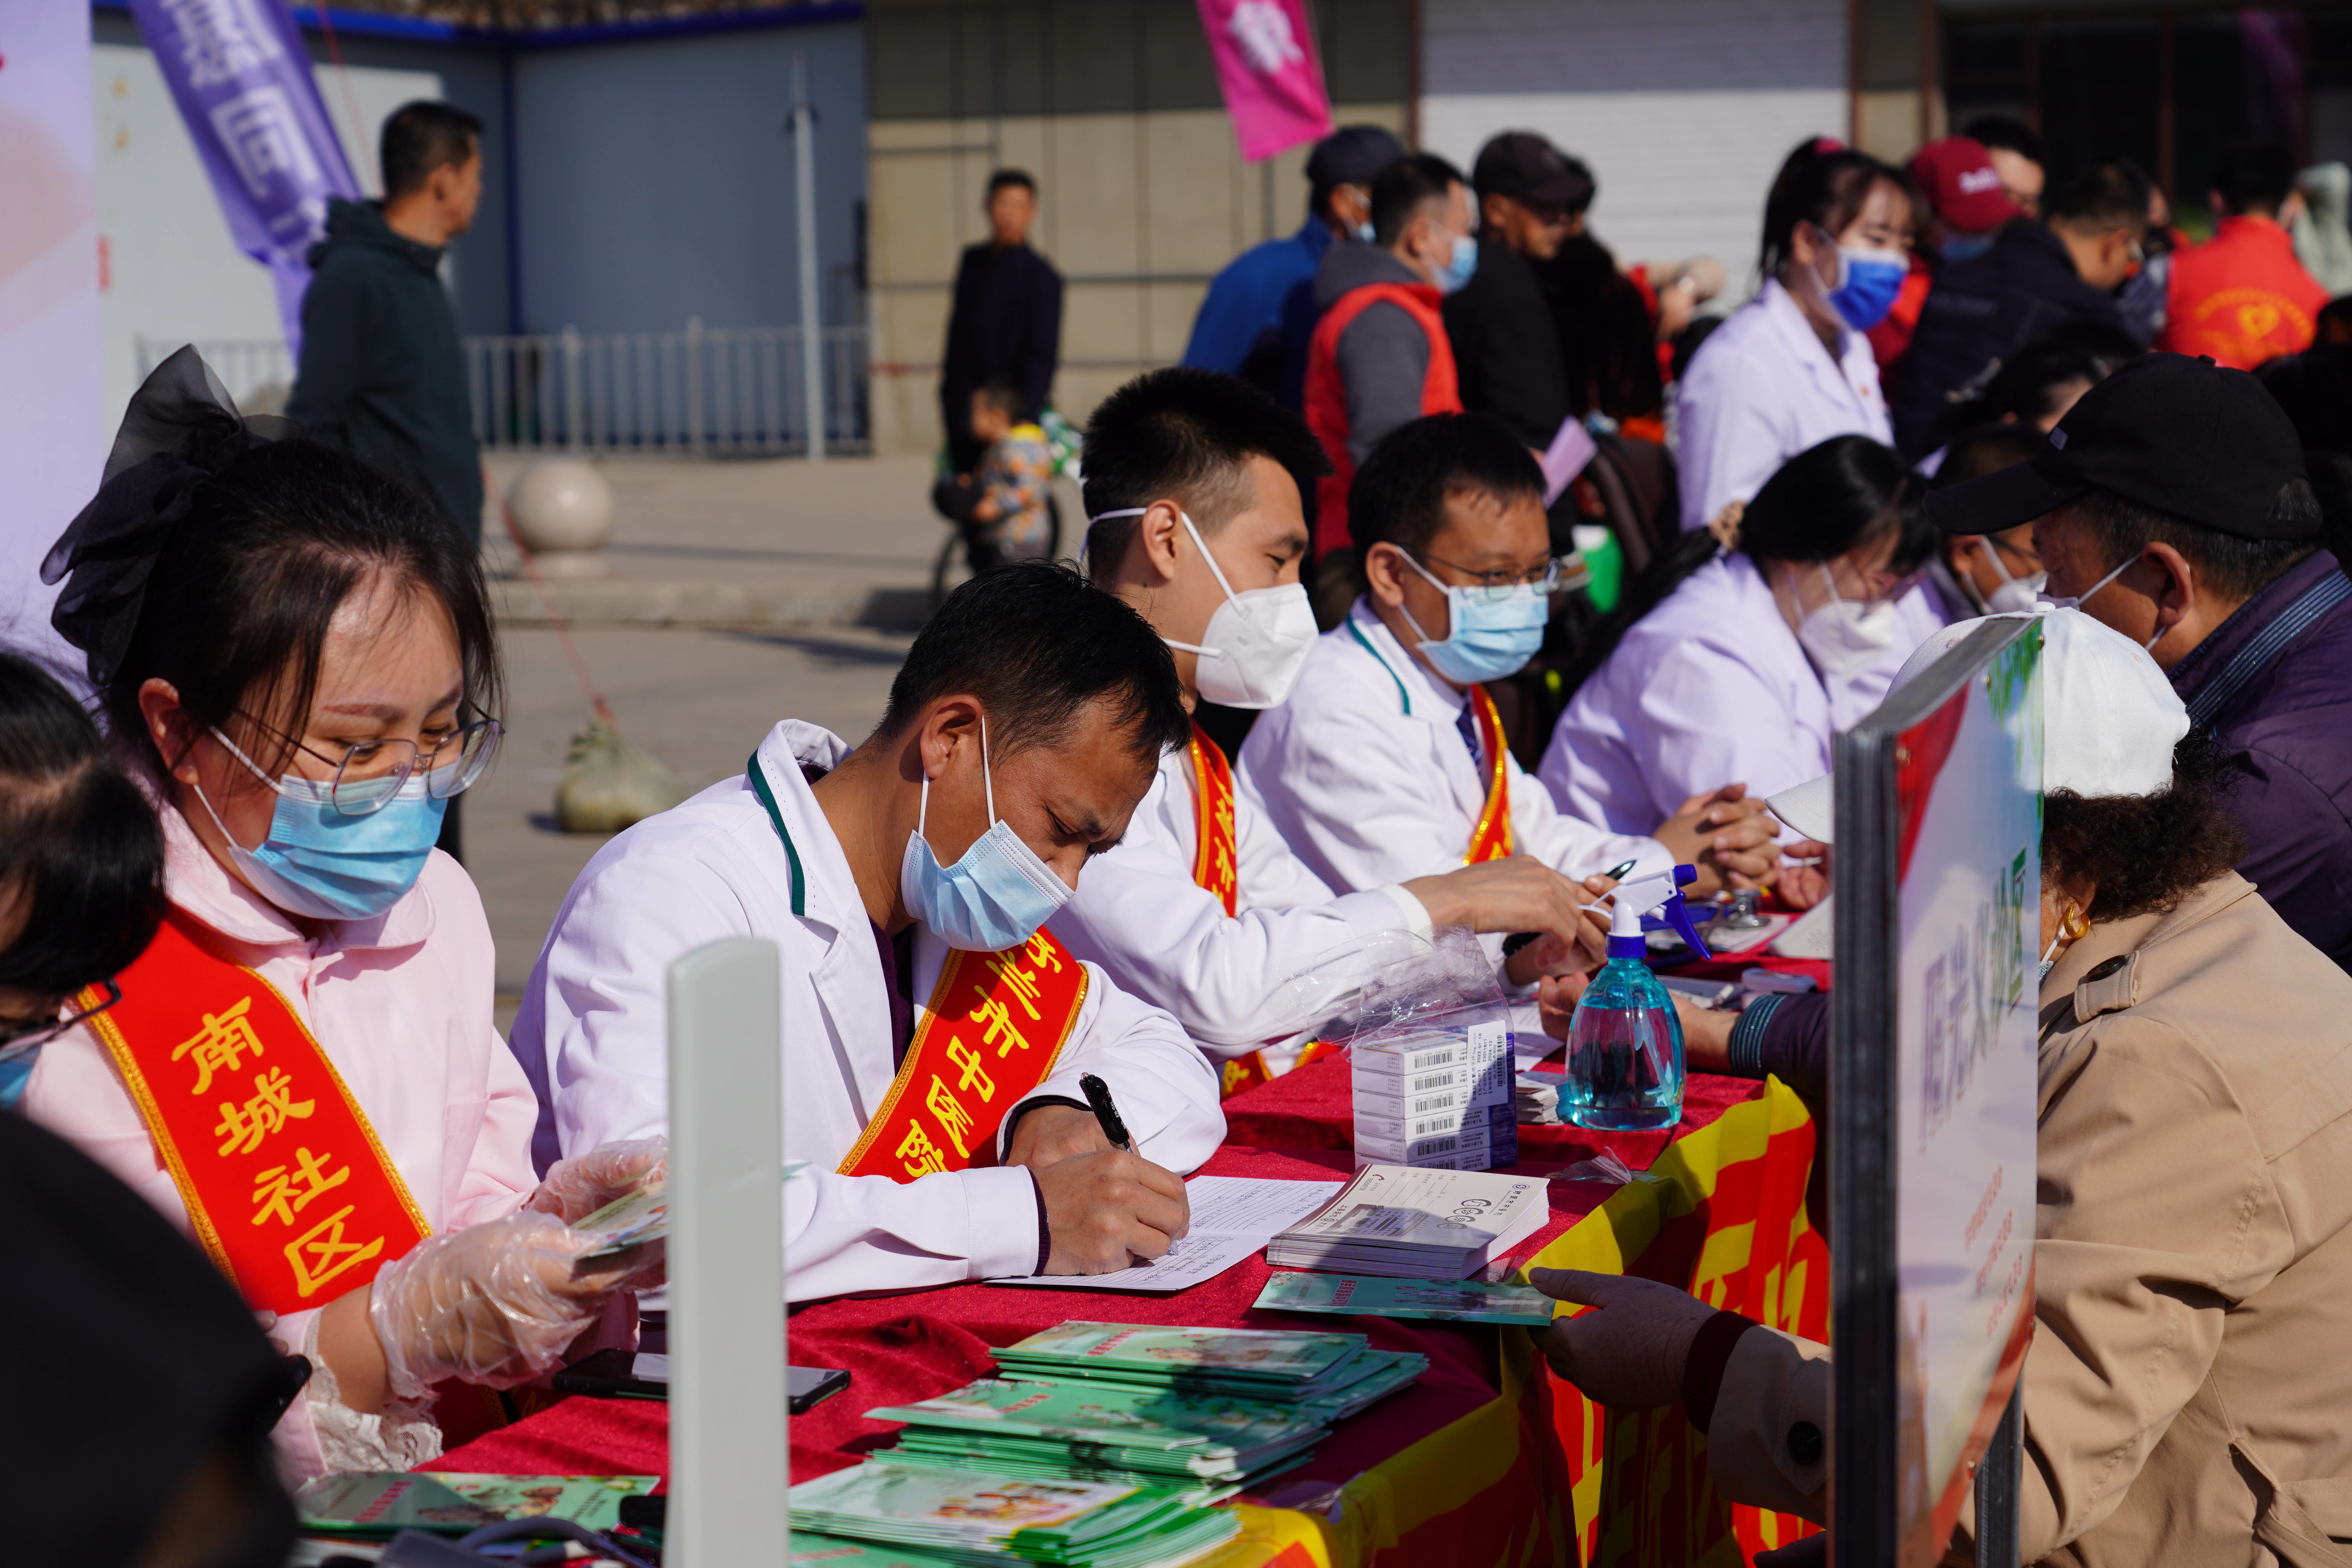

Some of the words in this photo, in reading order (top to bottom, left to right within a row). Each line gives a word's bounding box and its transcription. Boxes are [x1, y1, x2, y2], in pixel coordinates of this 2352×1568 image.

[172, 995, 384, 1298] 南城社区
[1358, 1178, 1375, 1190] 68256739
